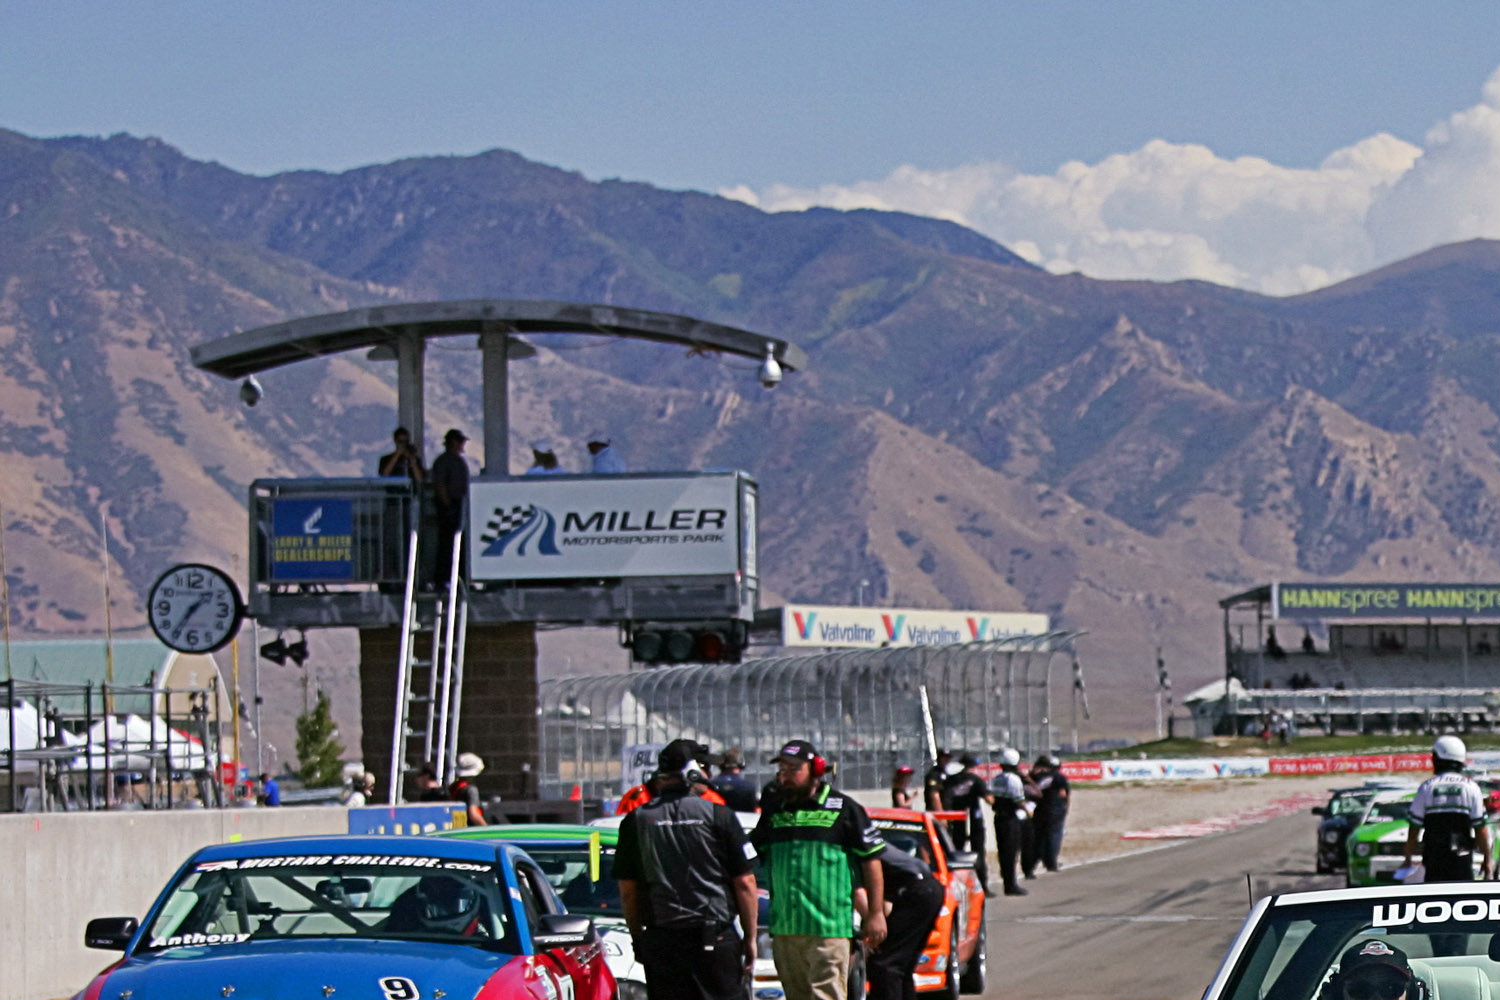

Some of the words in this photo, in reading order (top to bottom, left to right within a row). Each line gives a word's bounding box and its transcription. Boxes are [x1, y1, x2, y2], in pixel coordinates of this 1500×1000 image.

[563, 509, 727, 532] MILLER
[563, 533, 679, 547] MOTORSPORTS
[683, 533, 724, 545] PARK
[275, 548, 351, 562] DEALERSHIPS
[188, 573, 204, 589] 12
[159, 600, 171, 617] 9
[1282, 588, 1400, 613] HANNspree
[217, 602, 229, 618] 3
[186, 630, 199, 646] 6
[820, 622, 876, 642] Valvoline
[150, 932, 251, 948] Anthony
